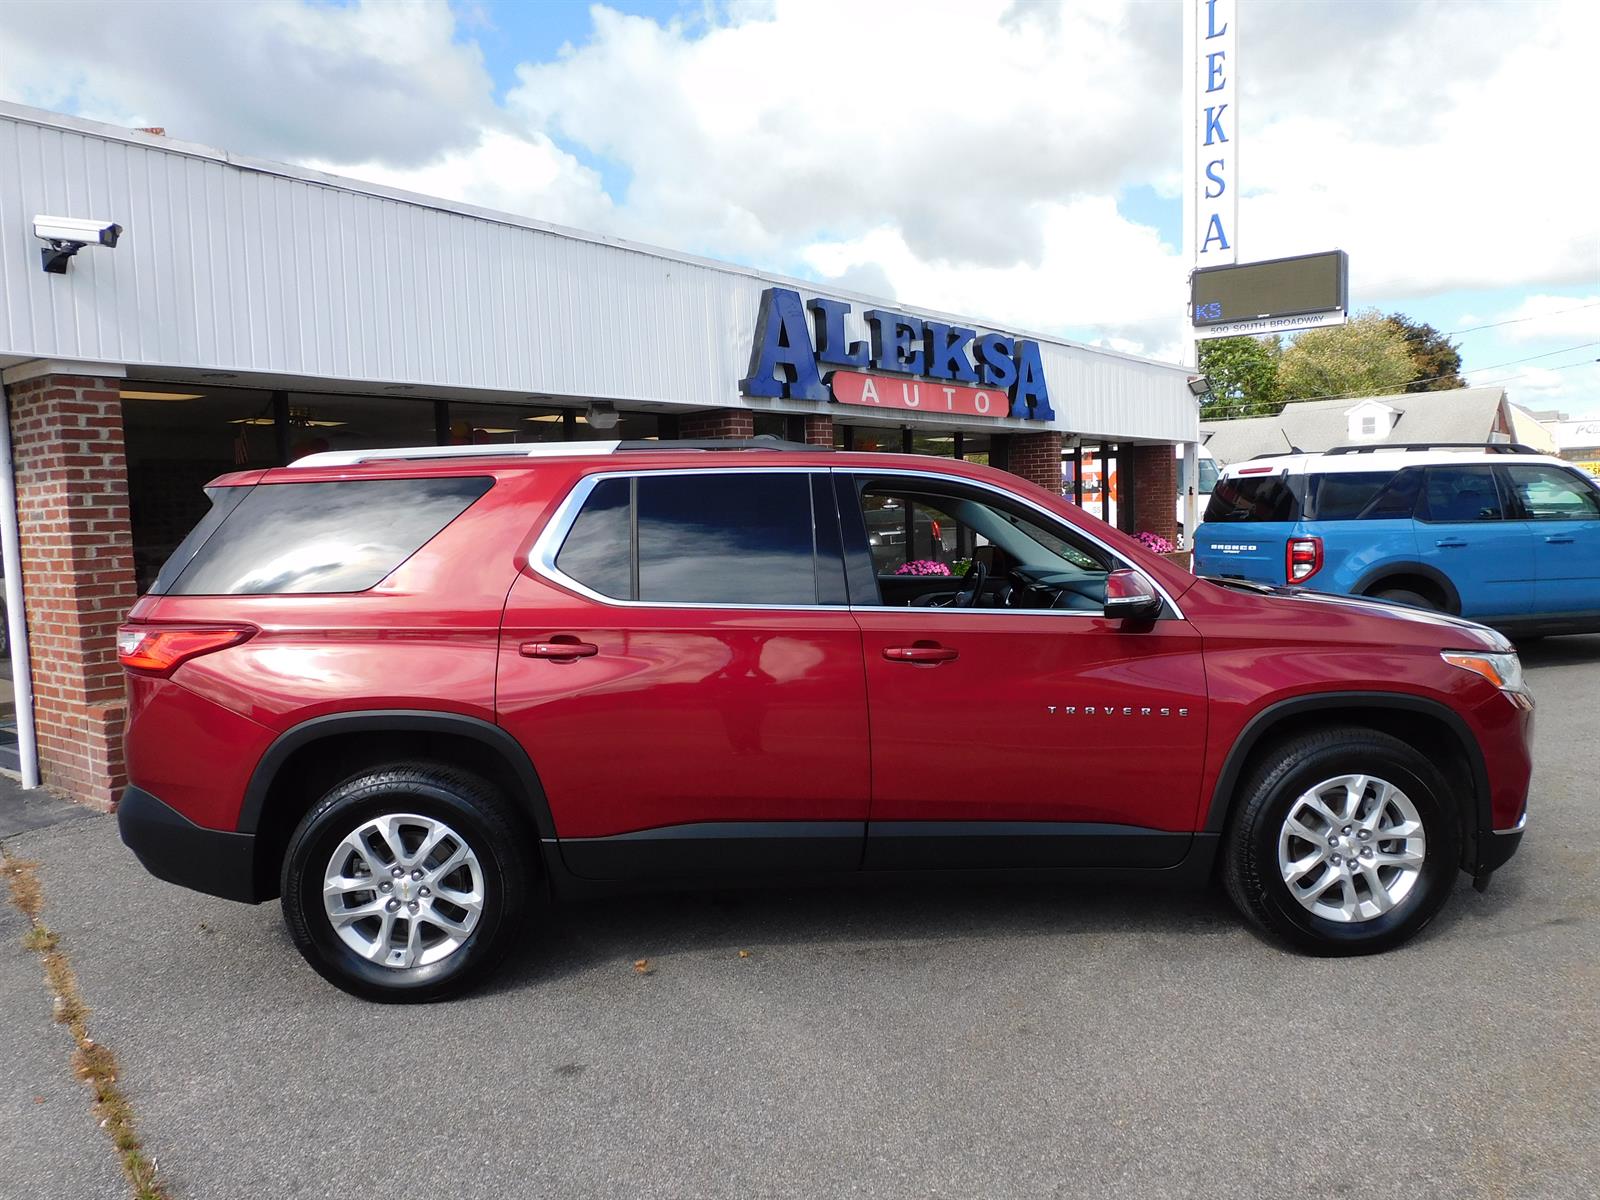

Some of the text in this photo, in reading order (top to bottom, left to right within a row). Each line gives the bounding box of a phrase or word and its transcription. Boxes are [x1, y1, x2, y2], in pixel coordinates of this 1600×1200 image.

[1210, 315, 1324, 335] 500 SOUTH BROADWAY
[739, 287, 1055, 421] ALEKSA
[861, 378, 990, 413] AUTO
[1047, 706, 1188, 716] TRAVERSE
